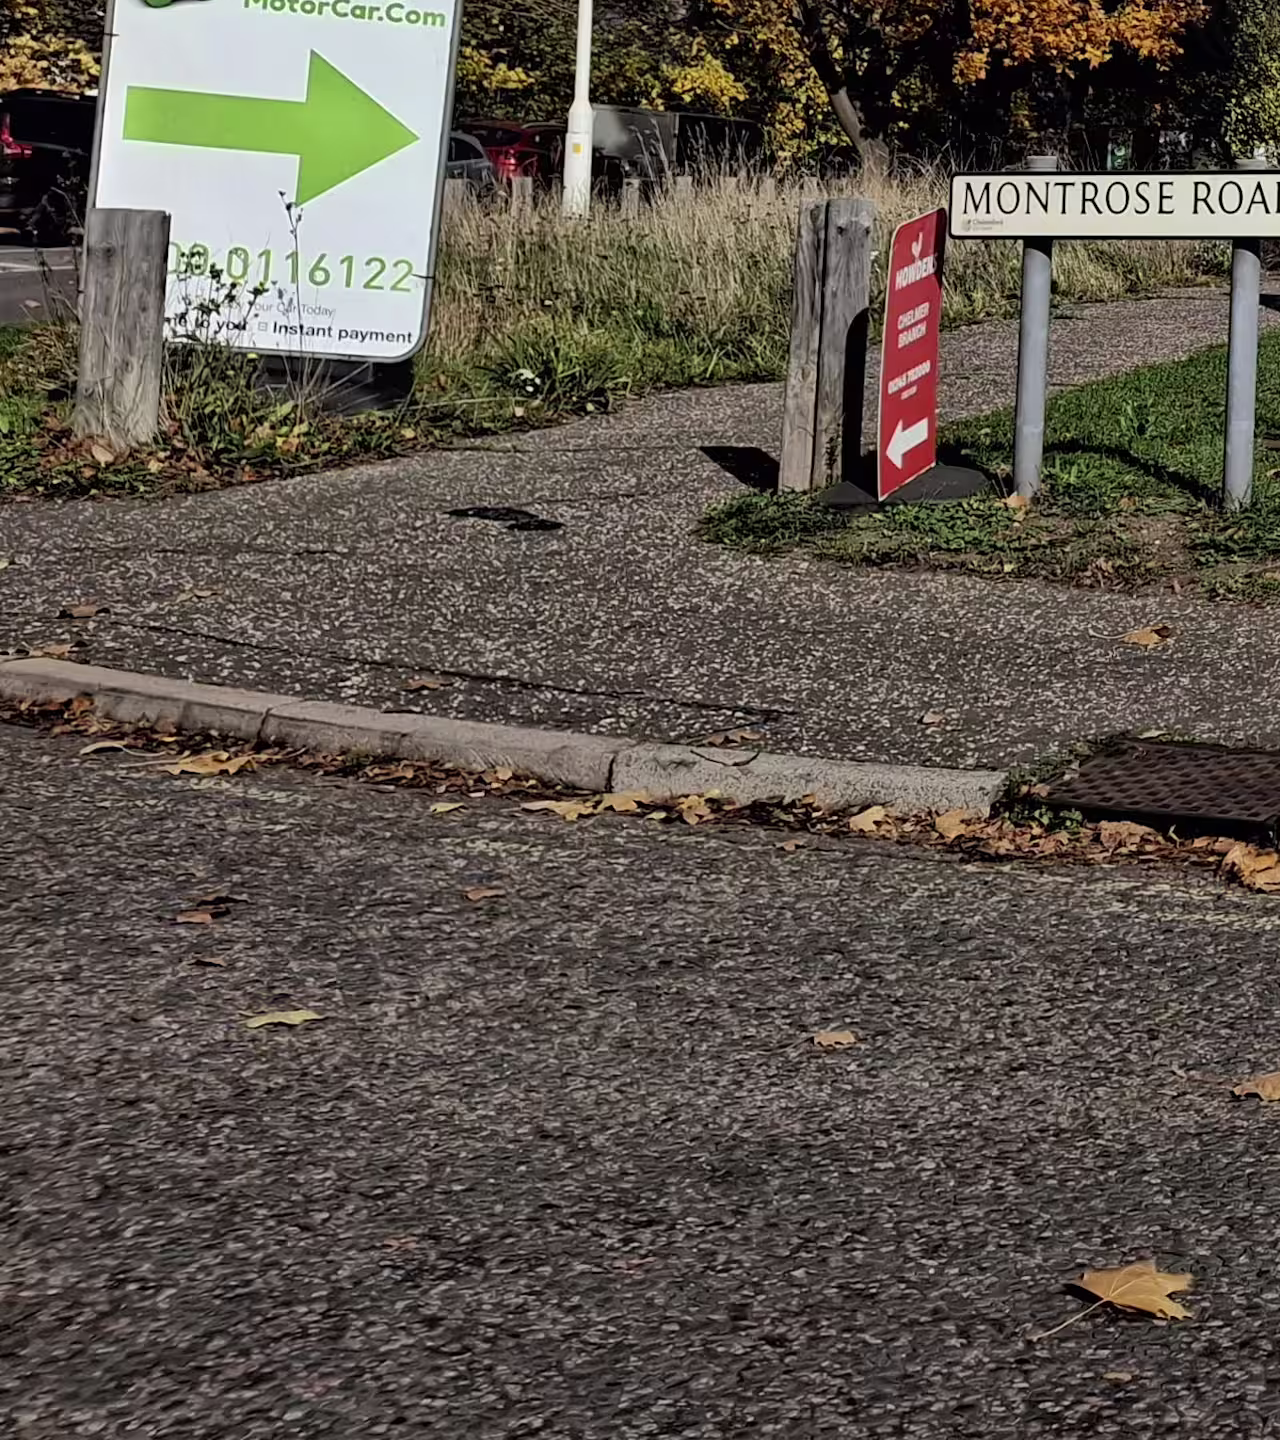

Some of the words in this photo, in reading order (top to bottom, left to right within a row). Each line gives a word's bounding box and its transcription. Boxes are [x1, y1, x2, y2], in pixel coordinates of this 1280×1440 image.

[963, 181, 1174, 214] MONTROSE
[273, 320, 333, 339] Instant
[338, 327, 413, 345] payment
